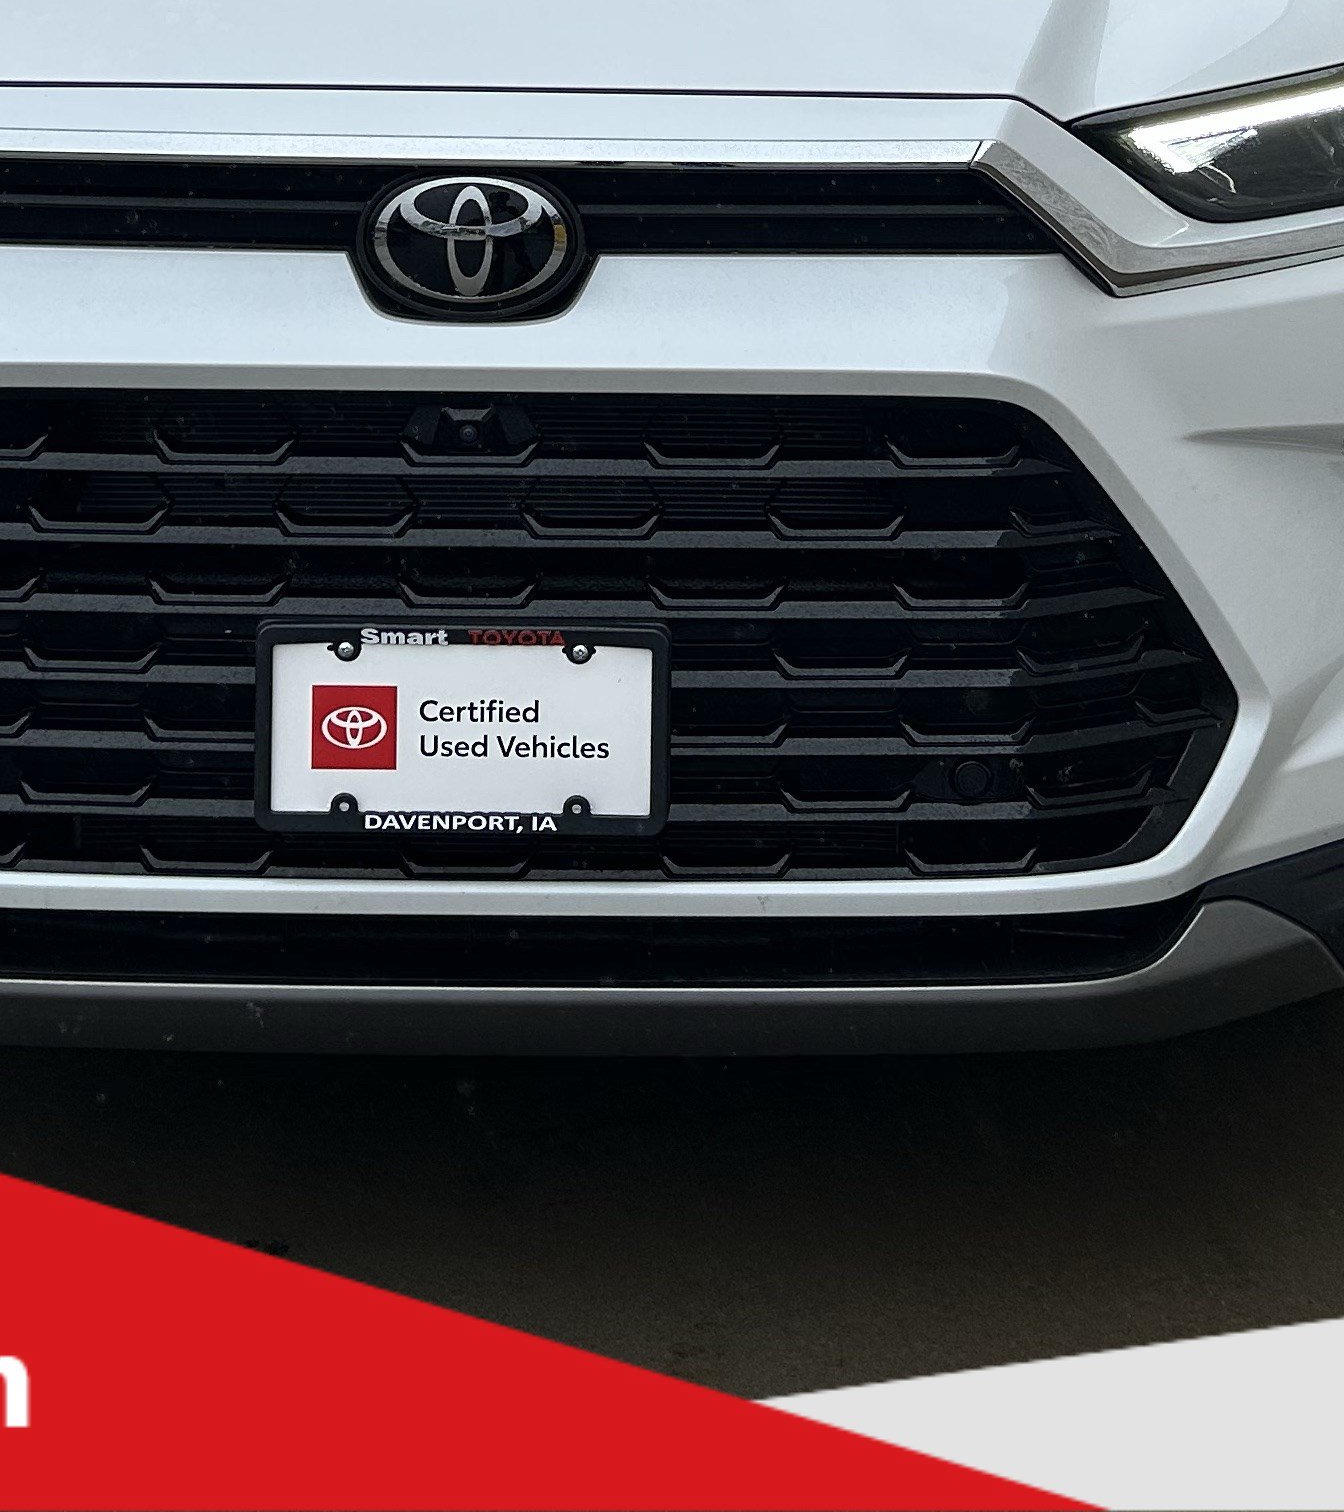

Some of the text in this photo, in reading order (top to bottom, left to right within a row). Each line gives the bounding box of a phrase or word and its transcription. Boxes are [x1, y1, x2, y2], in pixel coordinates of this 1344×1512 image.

[361, 628, 566, 646] Smart TOYOTA
[419, 699, 540, 723] Certified
[420, 734, 610, 759] Used Vehicles
[364, 814, 557, 834] DAVENPORT, IA
